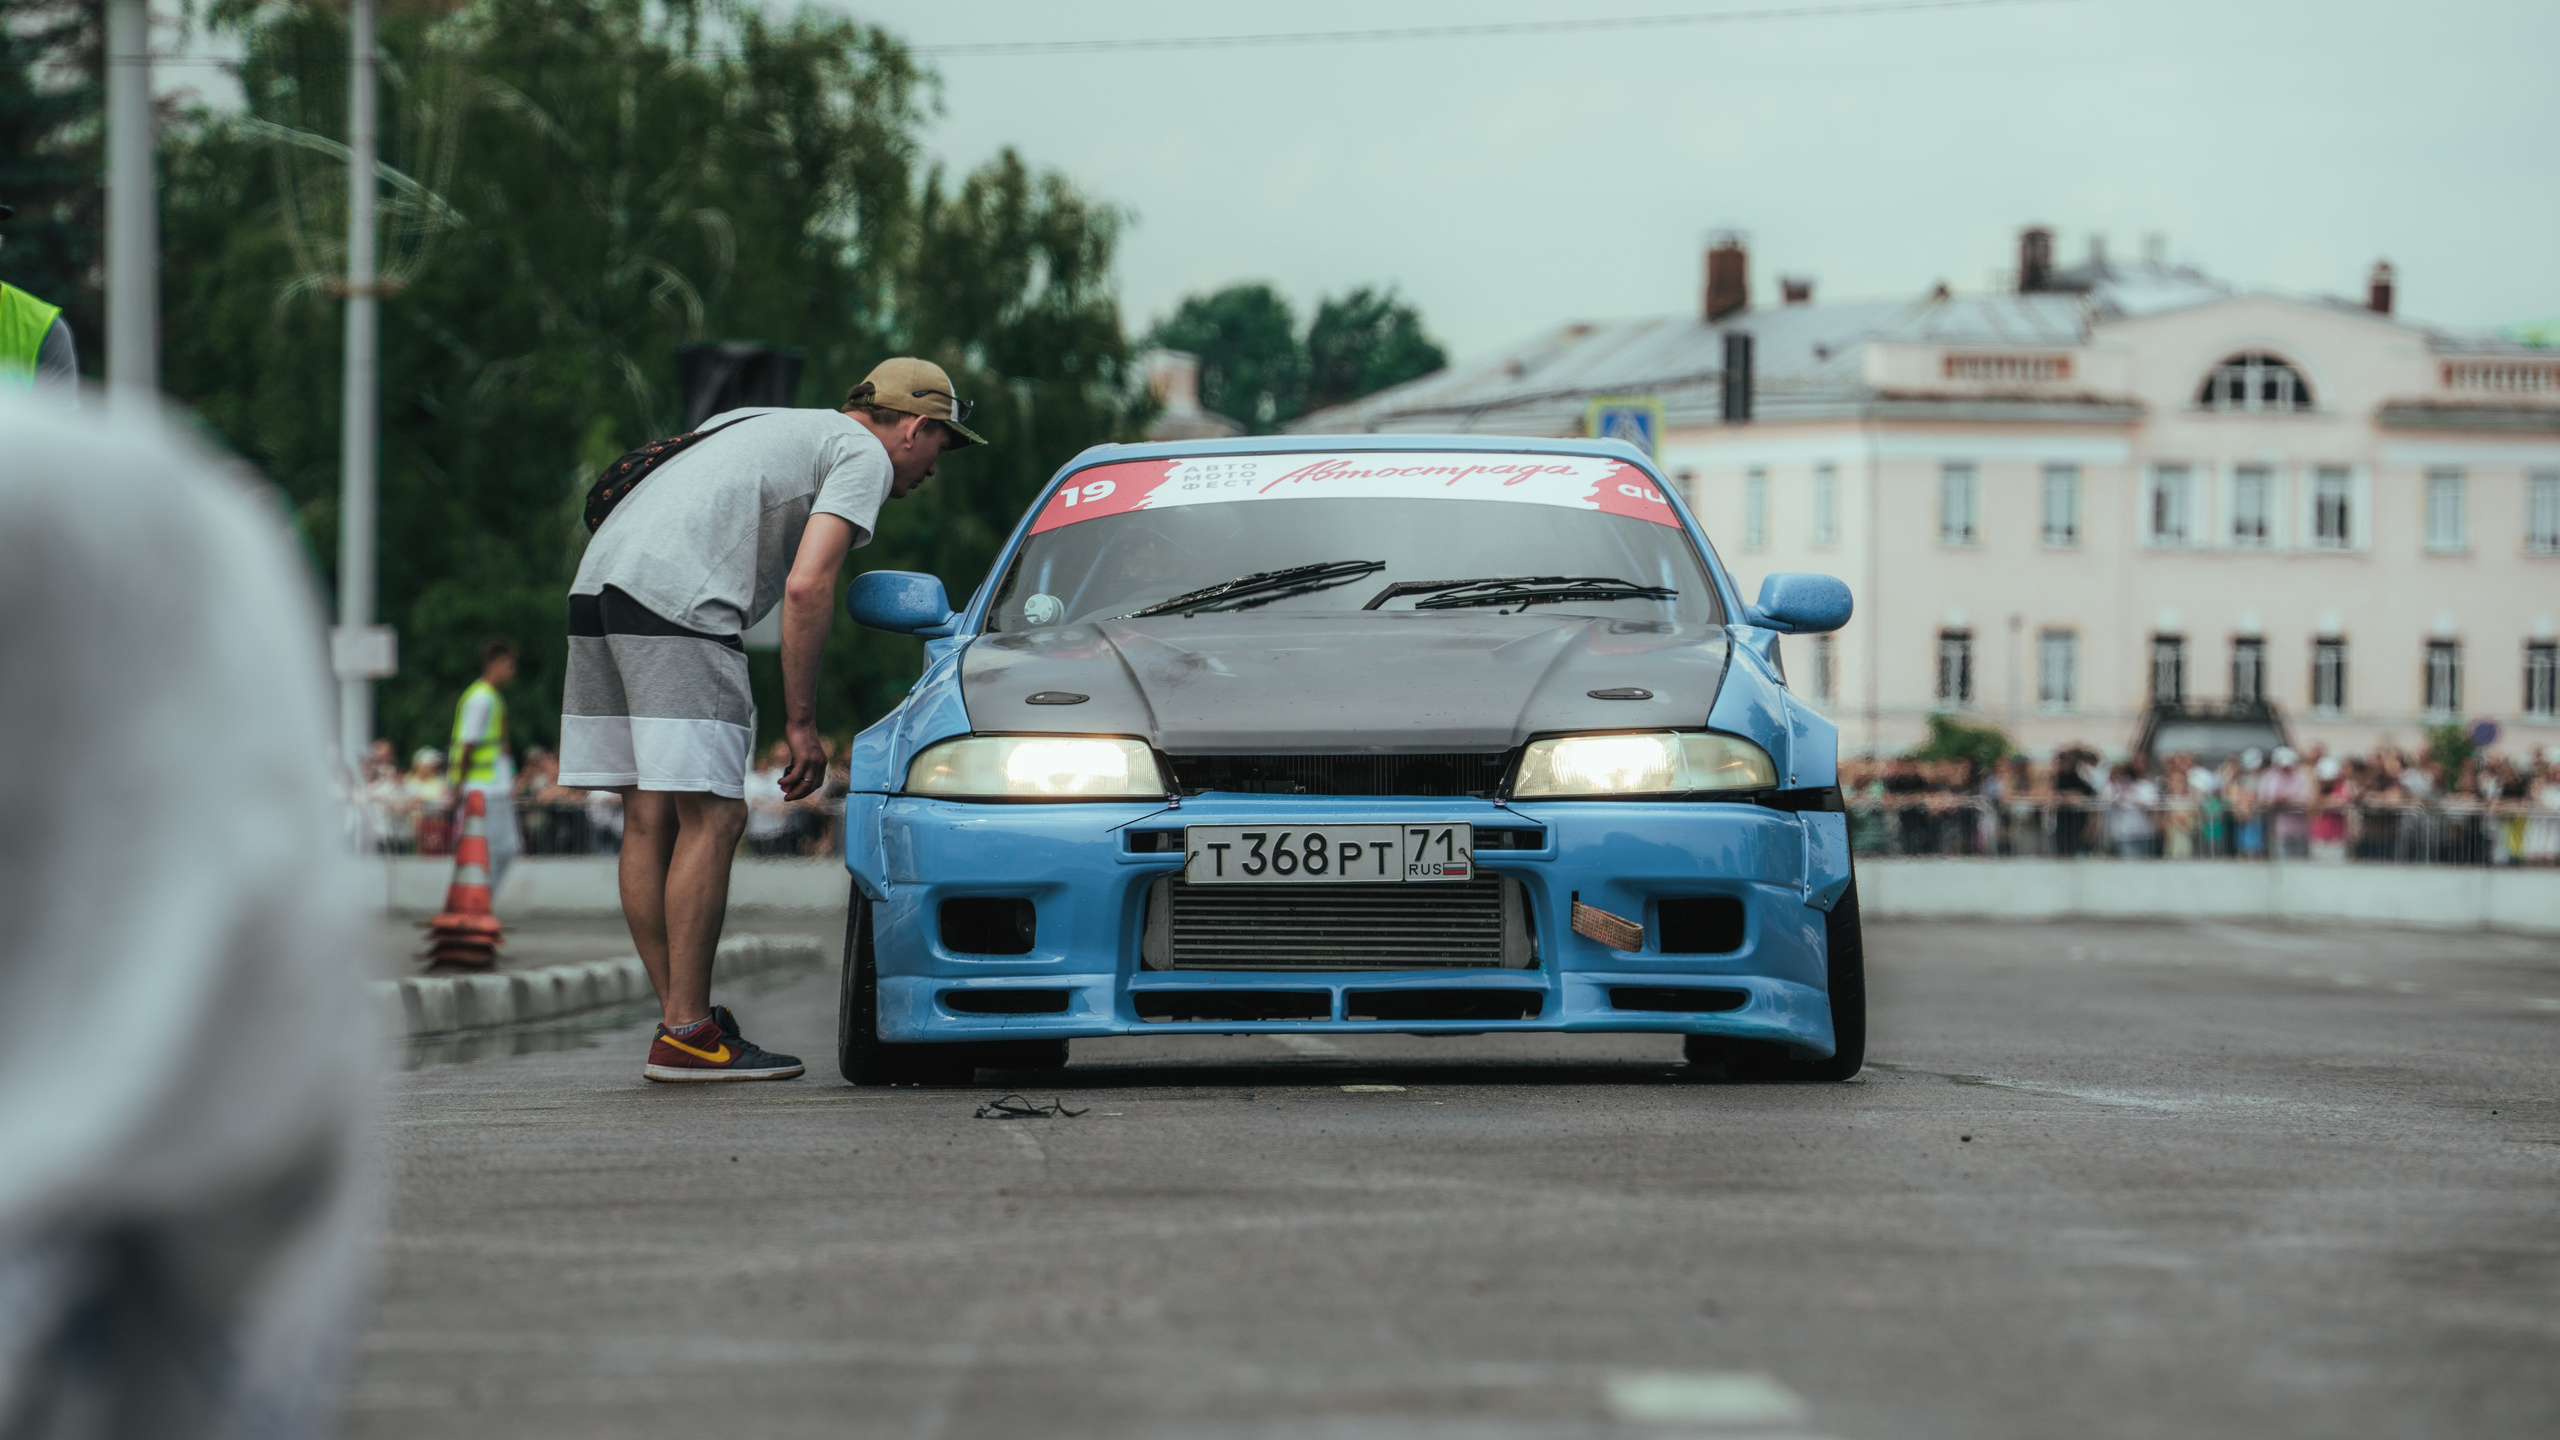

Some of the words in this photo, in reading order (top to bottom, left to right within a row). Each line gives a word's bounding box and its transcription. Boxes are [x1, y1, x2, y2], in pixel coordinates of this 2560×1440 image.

[1184, 463, 1258, 474] АВТО
[1183, 471, 1257, 482] МОТО
[1258, 458, 1580, 495] Автострада
[1181, 479, 1257, 491] ФЕСТ
[1060, 480, 1117, 508] 19
[1409, 828, 1454, 862] 71
[1408, 864, 1442, 876] RUS
